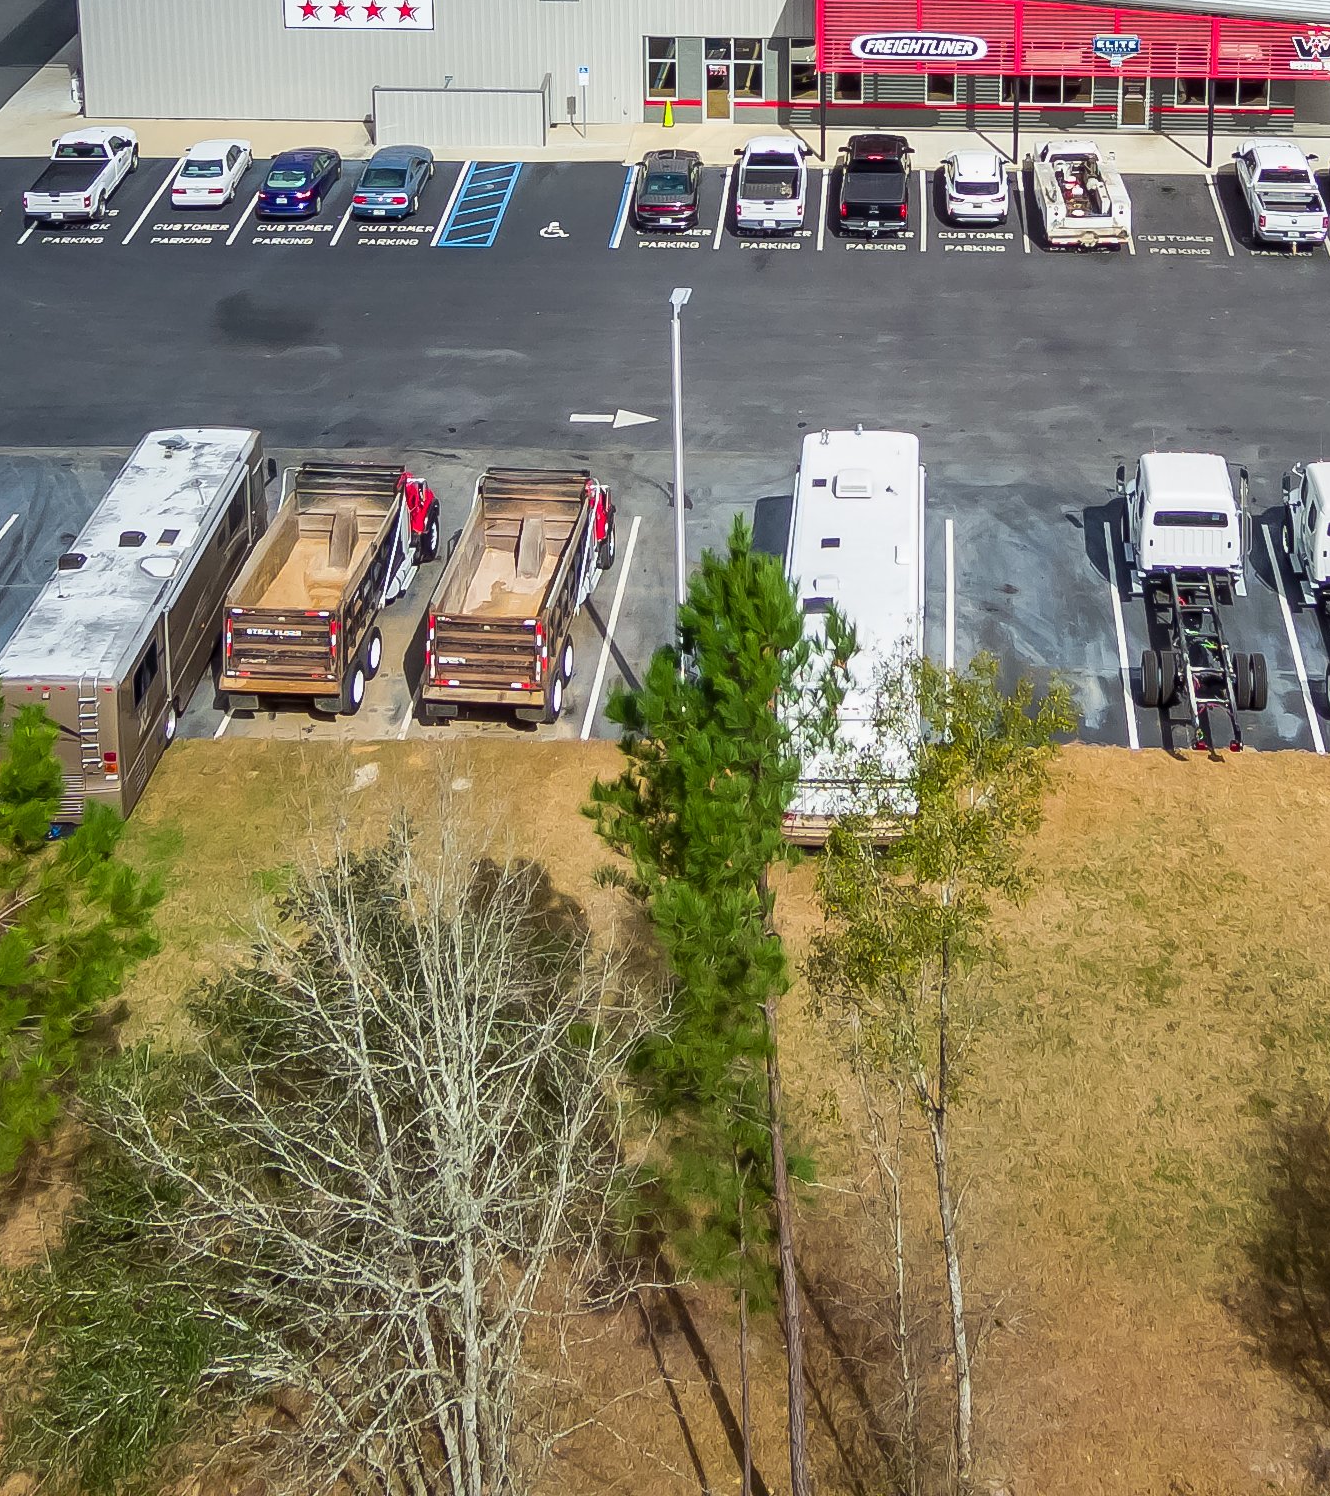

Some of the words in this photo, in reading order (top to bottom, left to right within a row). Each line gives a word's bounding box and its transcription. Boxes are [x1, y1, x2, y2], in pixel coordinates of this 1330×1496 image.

[864, 39, 974, 55] FREIGHTLINER
[1096, 40, 1137, 49] ELITE
[152, 222, 230, 232] CUSTOMER
[256, 224, 334, 233] CUSTOMER
[358, 224, 435, 233] CUSTOMER
[937, 231, 1014, 240] CUSTOMER
[1137, 234, 1215, 243] CUSTOMER
[41, 236, 105, 245] PARKING
[150, 236, 213, 245] PARKING
[252, 237, 314, 246] PARKING
[358, 238, 419, 247] PARKING
[638, 241, 700, 249] PARKING
[739, 242, 801, 250] PARKING
[845, 243, 907, 251] PARKING
[944, 244, 1006, 252] PARKING
[1148, 246, 1212, 255] PARKING
